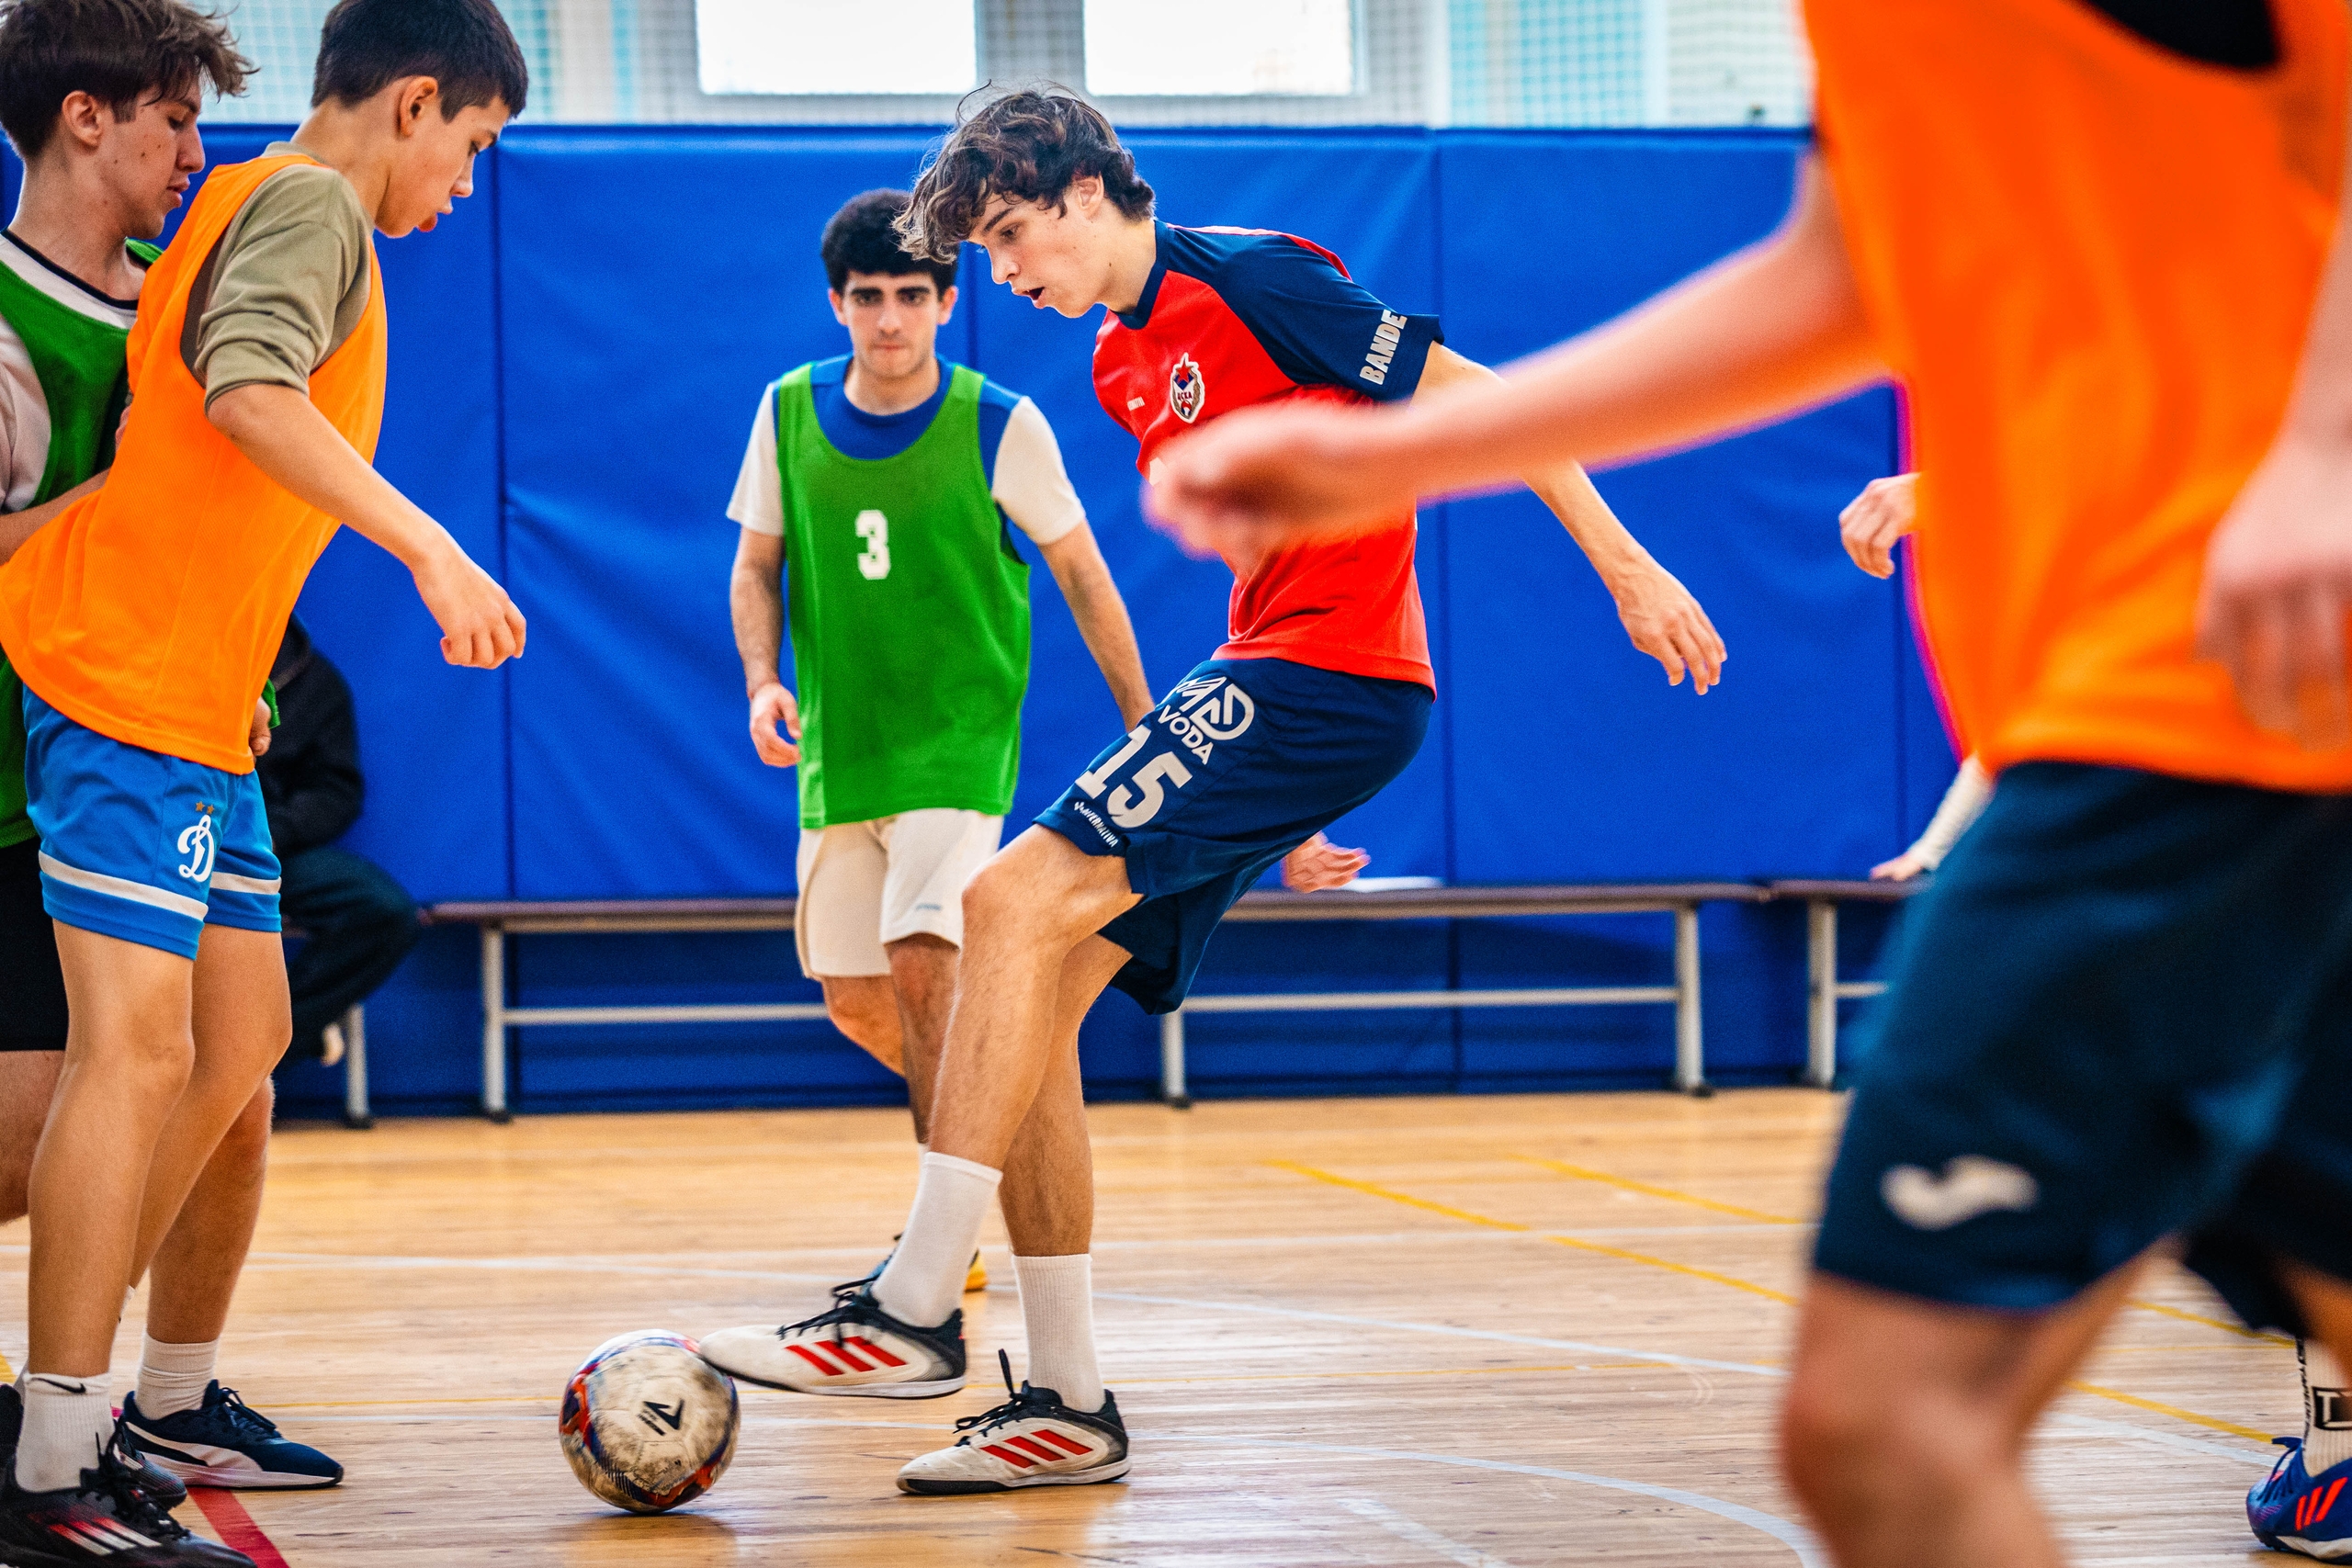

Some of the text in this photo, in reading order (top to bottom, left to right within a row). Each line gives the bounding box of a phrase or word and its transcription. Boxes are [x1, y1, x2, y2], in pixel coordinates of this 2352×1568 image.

[1360, 309, 1408, 386] BANDE
[854, 509, 892, 581] 3
[1158, 705, 1214, 765] VODA
[1075, 724, 1193, 829] 15
